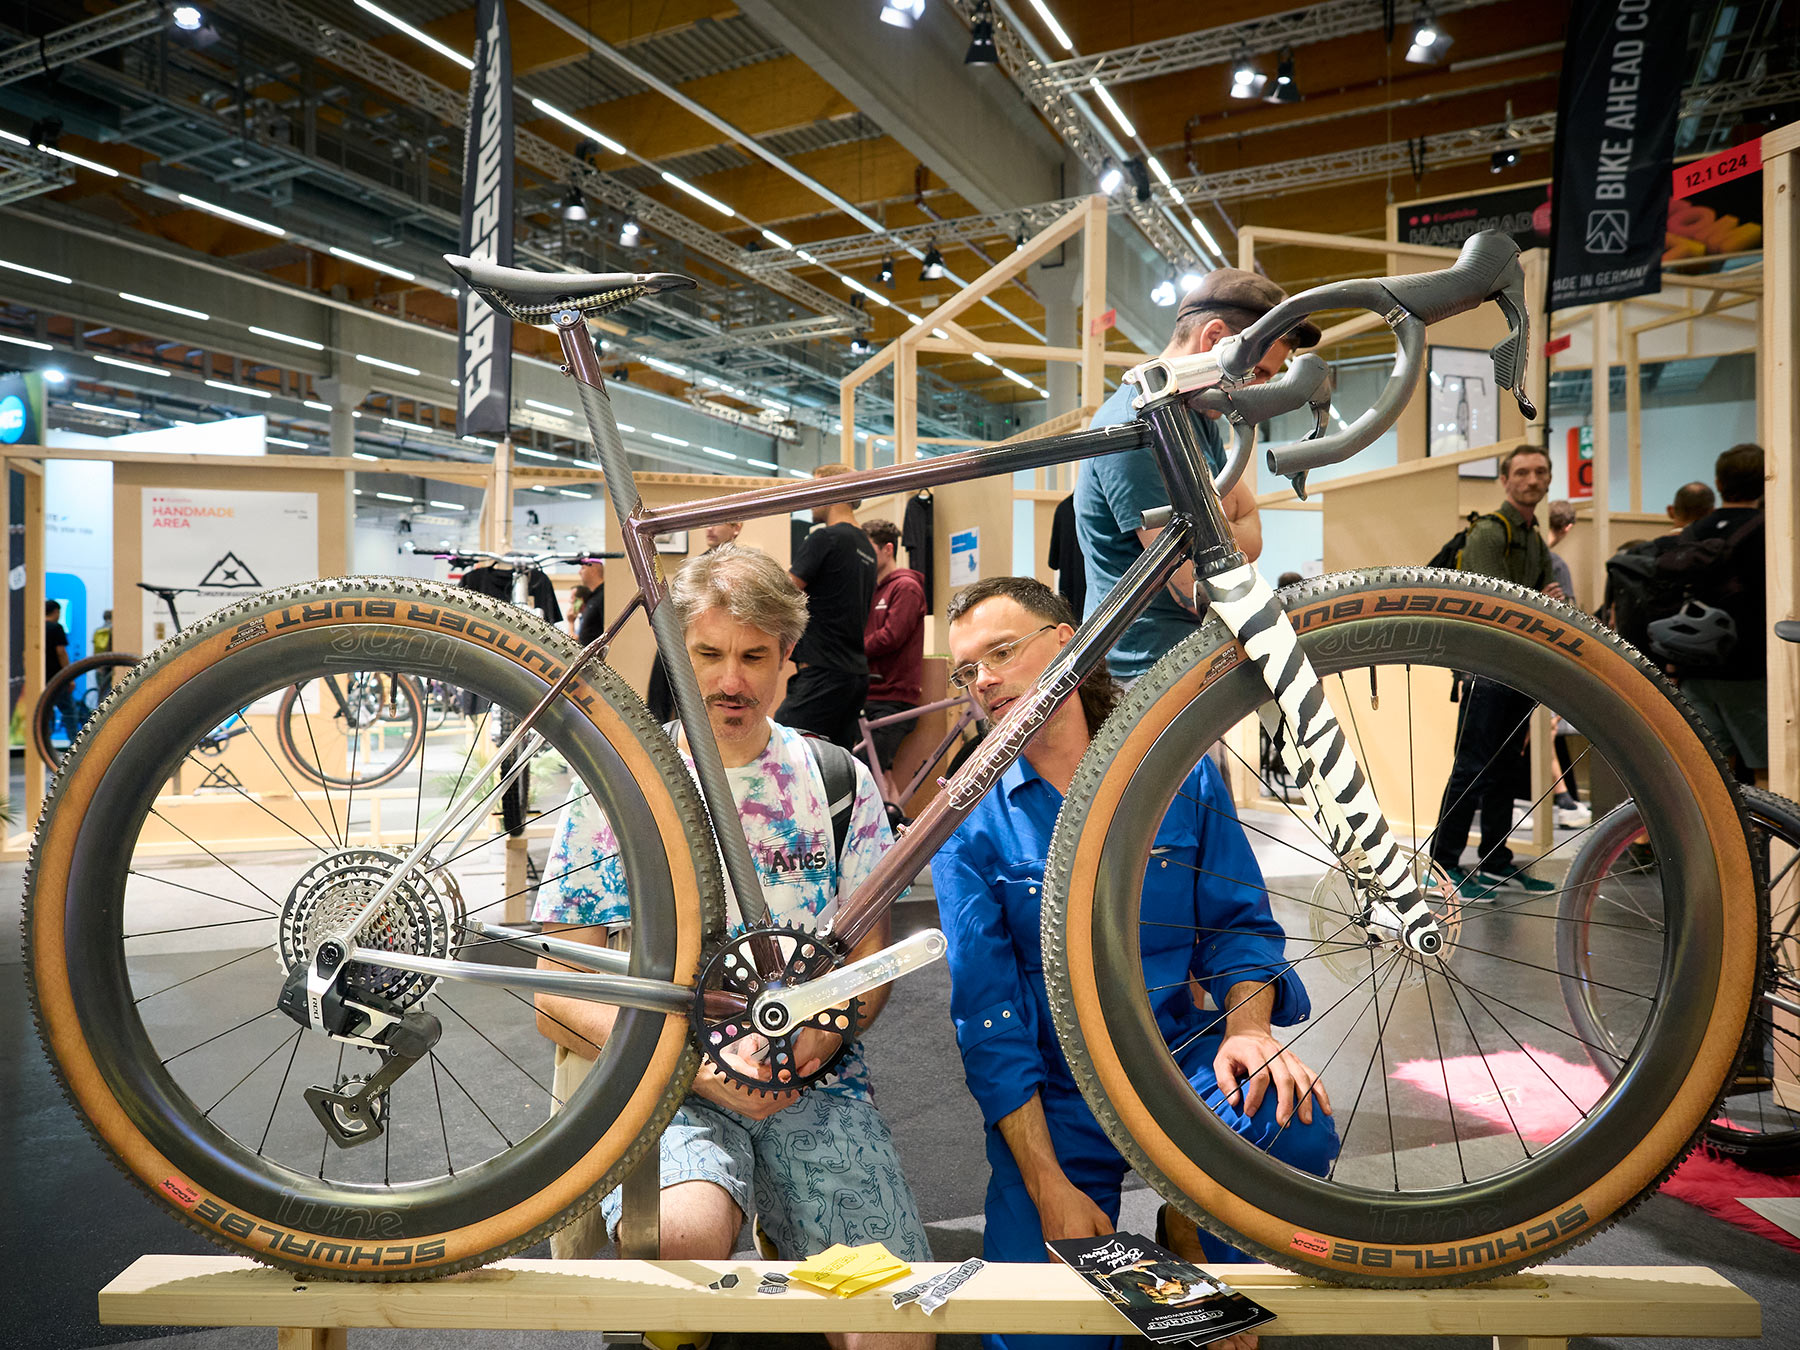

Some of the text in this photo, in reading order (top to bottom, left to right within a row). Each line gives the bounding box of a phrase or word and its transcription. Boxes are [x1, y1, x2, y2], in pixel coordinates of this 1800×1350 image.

[1603, 40, 1644, 131] AHEAD
[1595, 138, 1634, 200] BIKE
[1685, 154, 1748, 189] 12.1 C24
[1579, 274, 1592, 288] IN
[1595, 264, 1649, 286] GERMANY
[152, 506, 234, 518] HANDMADE
[152, 518, 191, 528] AREA
[250, 618, 263, 627] EVO
[275, 600, 397, 630] BURT
[1374, 595, 1585, 658] THUNDER
[771, 847, 826, 873] Aries
[194, 1199, 446, 1265] SCHWALBE
[1332, 1203, 1590, 1269] SCHWALBE
[1077, 1248, 1109, 1266] own!
[1096, 1242, 1125, 1263] your
[1107, 1248, 1144, 1269] Build
